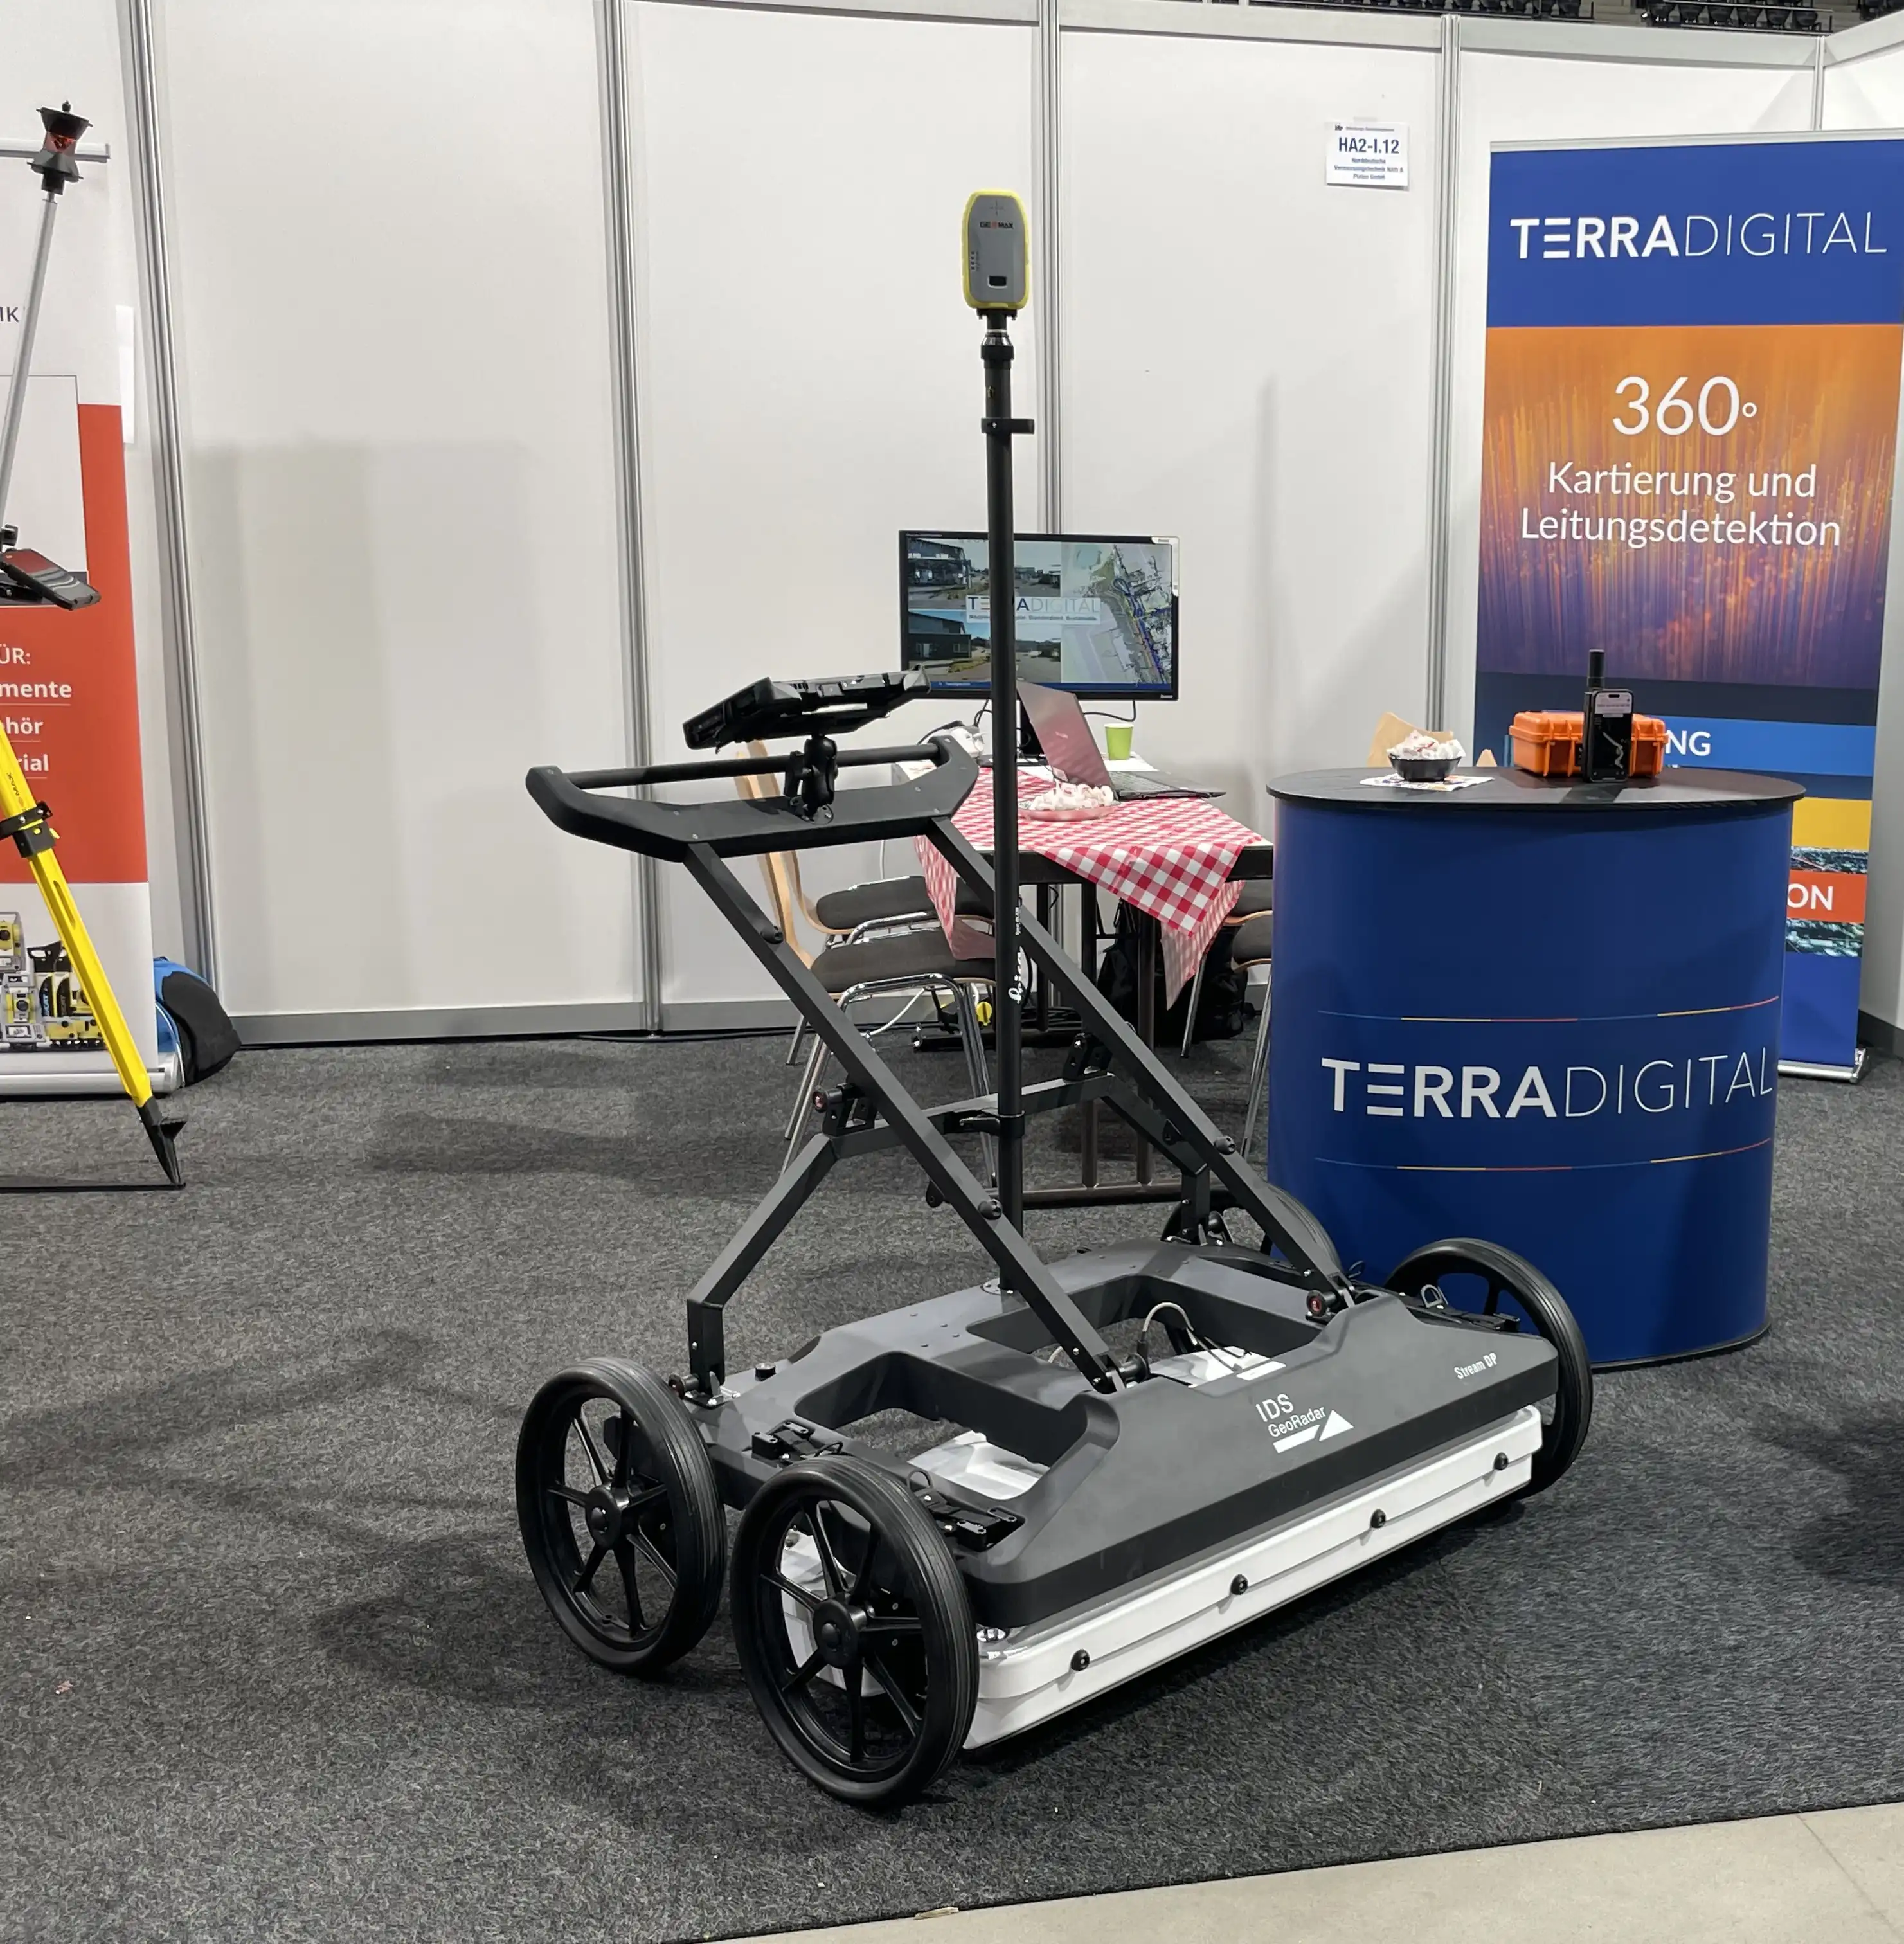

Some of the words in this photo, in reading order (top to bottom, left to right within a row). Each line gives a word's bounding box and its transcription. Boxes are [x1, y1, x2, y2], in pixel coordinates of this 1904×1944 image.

[1339, 137, 1399, 154] HA2-I.12
[1510, 212, 1887, 260] TERRADIGITAL
[1613, 376, 1757, 436] 360°
[1549, 461, 1736, 504] Kartierung
[1748, 464, 1817, 497] und
[1522, 507, 1842, 549] Leitungsdetektion
[0, 643, 31, 665] ÜR:
[0, 681, 72, 698] mente
[5, 716, 44, 735] hör
[1664, 730, 1711, 757] NG
[1787, 883, 1834, 911] ON
[1321, 1047, 1773, 1118] TERRADIGITAL
[1454, 1360, 1486, 1380] Stream
[1483, 1352, 1497, 1367] DP
[1255, 1393, 1294, 1422] IDS
[1268, 1407, 1326, 1437] GeoRadar
